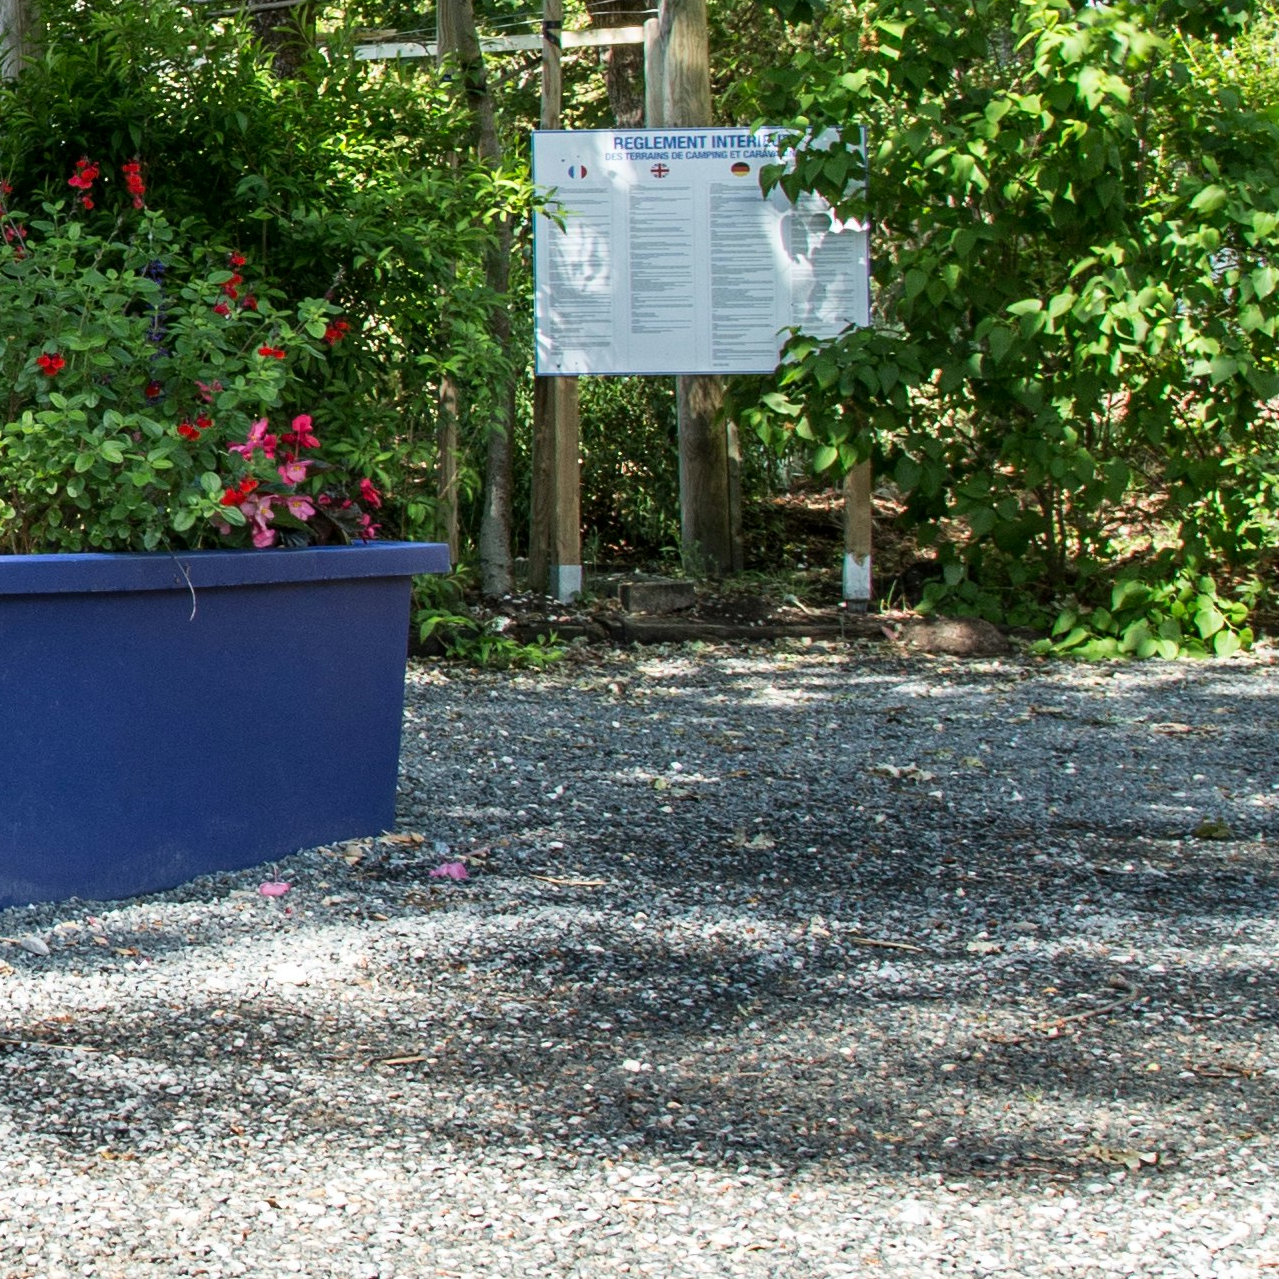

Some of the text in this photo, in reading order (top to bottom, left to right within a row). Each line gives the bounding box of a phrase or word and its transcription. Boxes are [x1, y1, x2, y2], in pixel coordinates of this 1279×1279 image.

[614, 136, 707, 150] REGLEMENT
[605, 153, 623, 161] DES
[625, 152, 669, 160] TERRAINS
[671, 152, 683, 160] DE
[686, 151, 728, 159] CAMPING
[730, 151, 740, 159] ET
